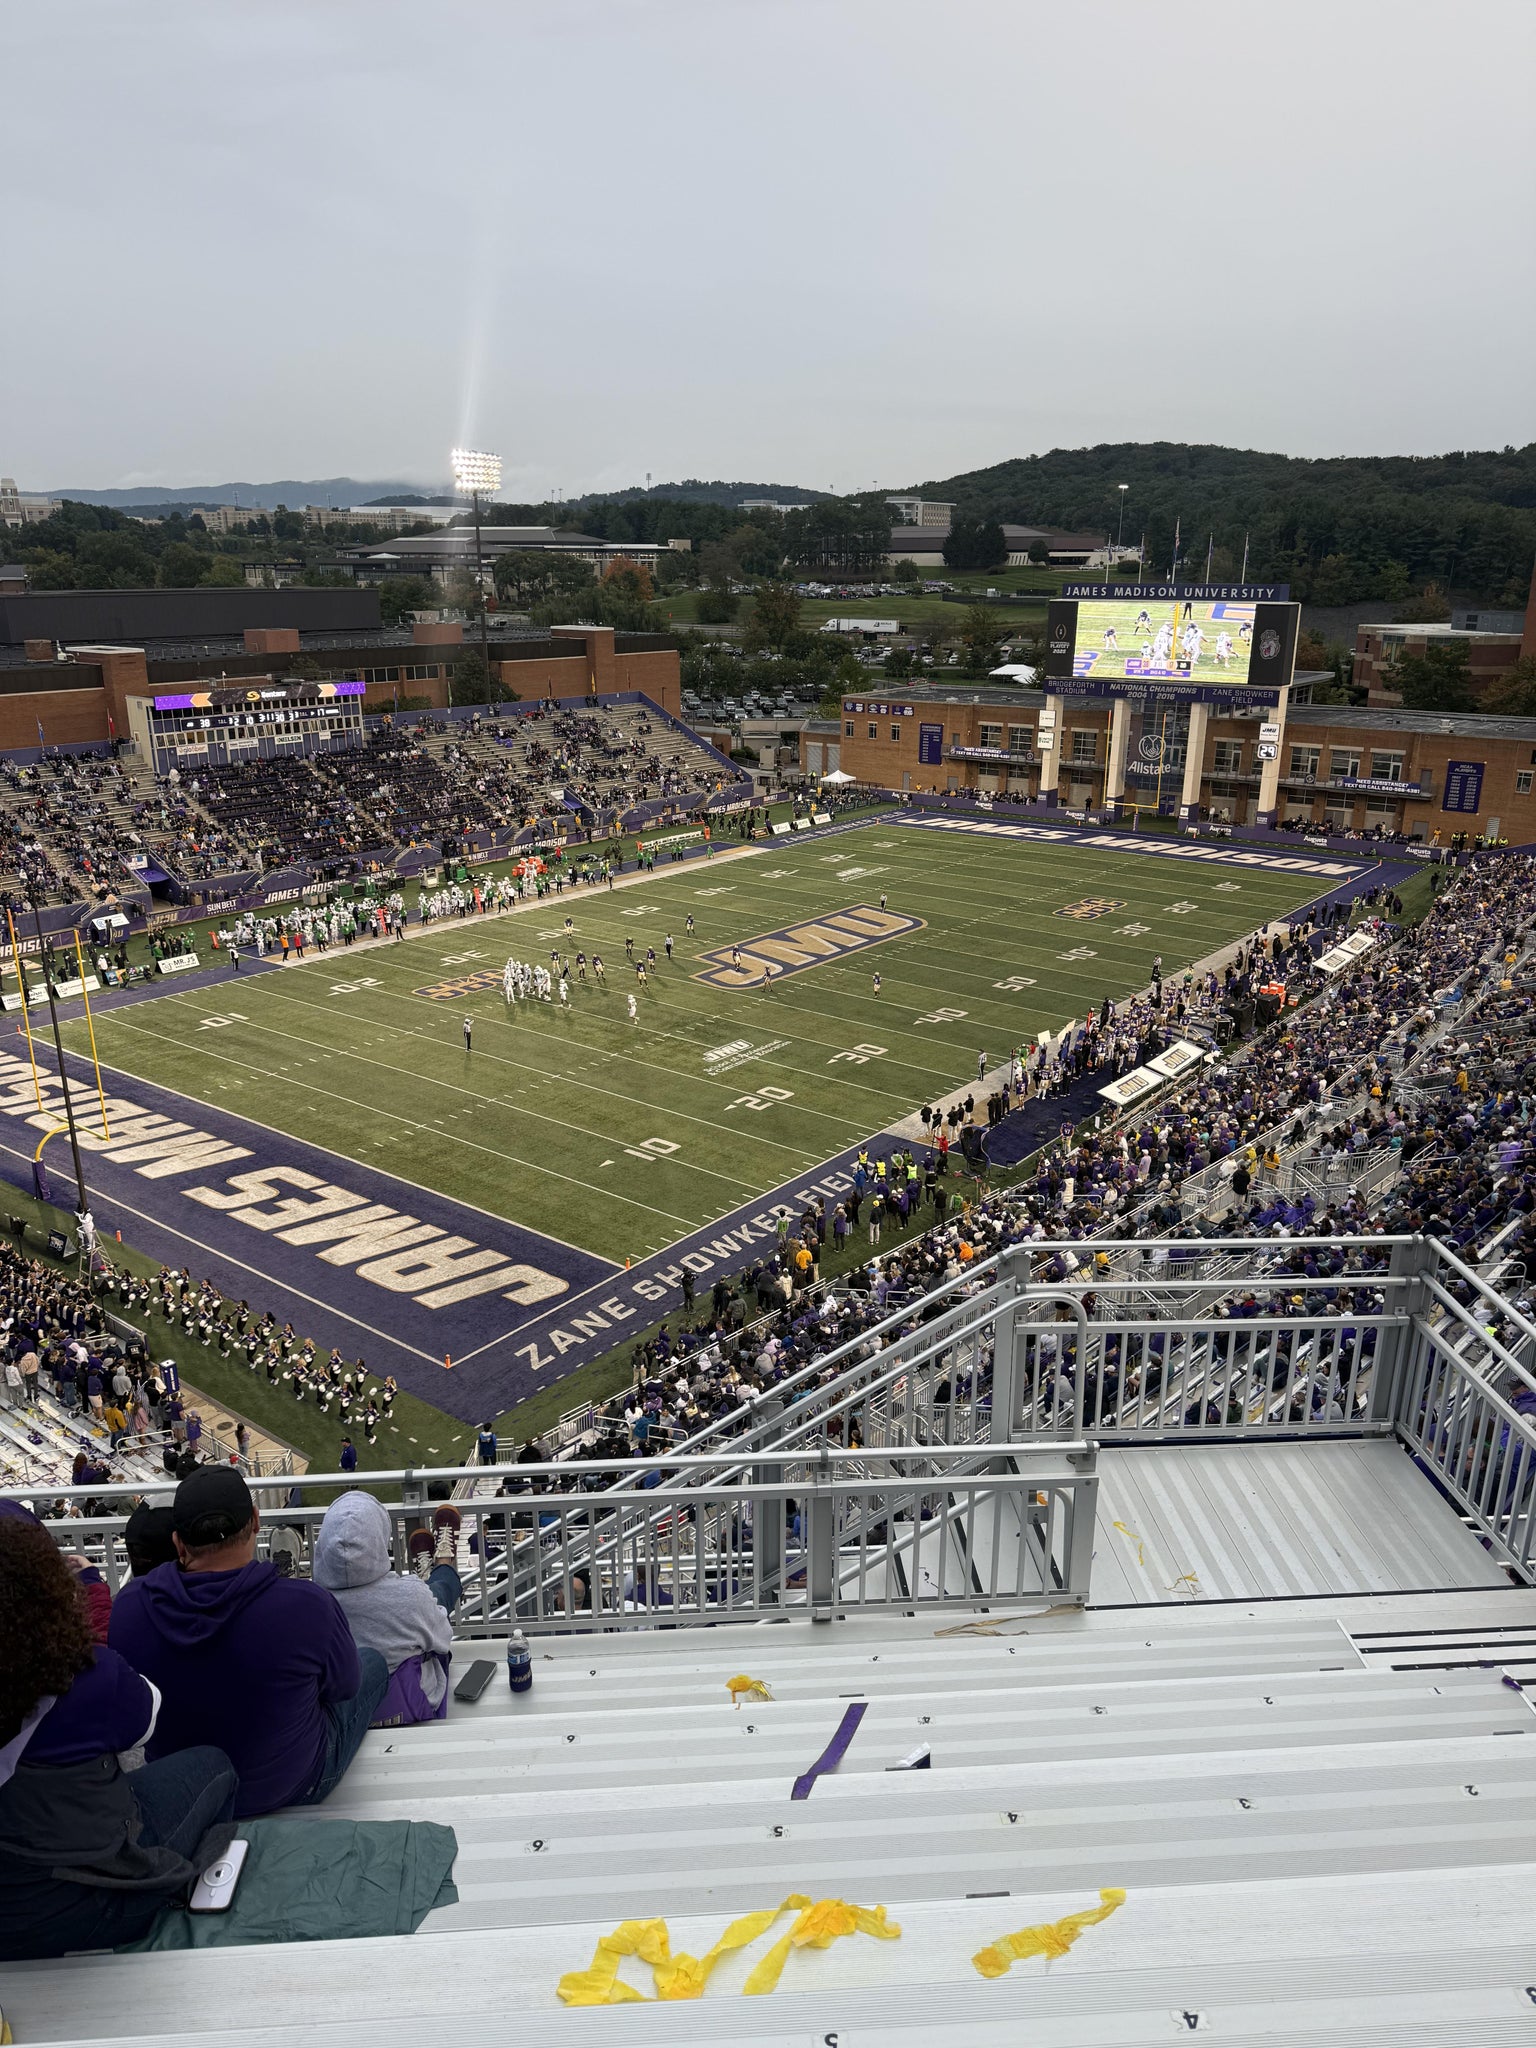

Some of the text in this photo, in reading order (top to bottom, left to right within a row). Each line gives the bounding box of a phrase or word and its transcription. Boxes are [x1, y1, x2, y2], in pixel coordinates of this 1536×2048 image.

[1066, 586, 1275, 598] JAMES MADISON UNIVERSITY
[1048, 680, 1095, 689] BRIDGEFORTH
[1109, 683, 1197, 694] NATIONAL CHAMPIONS
[1127, 691, 1175, 700] 2004 2016
[1212, 688, 1274, 698] ZANE SHOWKER
[1231, 696, 1253, 704] FIELD
[200, 718, 211, 728] 38
[1260, 746, 1275, 757] 29
[1127, 761, 1171, 775] Allstate
[1372, 779, 1409, 788] ASSISTANCE?
[1065, 810, 1085, 818] Augusta
[1303, 835, 1328, 844] Augusta
[896, 818, 1365, 875] JAMES MADISON
[1405, 846, 1431, 855] Augusta
[264, 888, 300, 904] JAMES
[206, 899, 237, 912] SUN BELT
[620, 904, 662, 916] 50
[1162, 902, 1199, 914] 20
[1112, 923, 1152, 936] 30
[703, 904, 920, 987] JMU
[443, 949, 491, 964] 30
[1056, 947, 1098, 961] 40
[173, 958, 186, 967] MR.
[329, 976, 385, 993] 20
[992, 975, 1038, 992] 50
[199, 1012, 250, 1028] 10
[920, 1007, 969, 1024] 40
[703, 1039, 754, 1062] JMU
[832, 1043, 889, 1064] 30
[1162, 1048, 1191, 1069] JMU
[1117, 1075, 1149, 1097] JMU
[733, 1086, 795, 1111] 20
[623, 1137, 682, 1162] 10
[180, 1166, 570, 1309] JAMES
[515, 1296, 637, 1371] ZANE
[632, 1202, 803, 1301] SHOWKER
[1263, 1696, 1273, 1705] 2
[1094, 1706, 1103, 1715] 3
[922, 1716, 931, 1724] 4
[746, 1725, 755, 1734] 5
[384, 1744, 393, 1753] 7
[1465, 1785, 1479, 1796] 2
[1238, 1798, 1251, 1810] 3
[1007, 1812, 1018, 1823] 4
[773, 1825, 783, 1838] 5
[1182, 2011, 1199, 2030] 4
[824, 2033, 838, 2048] 5
